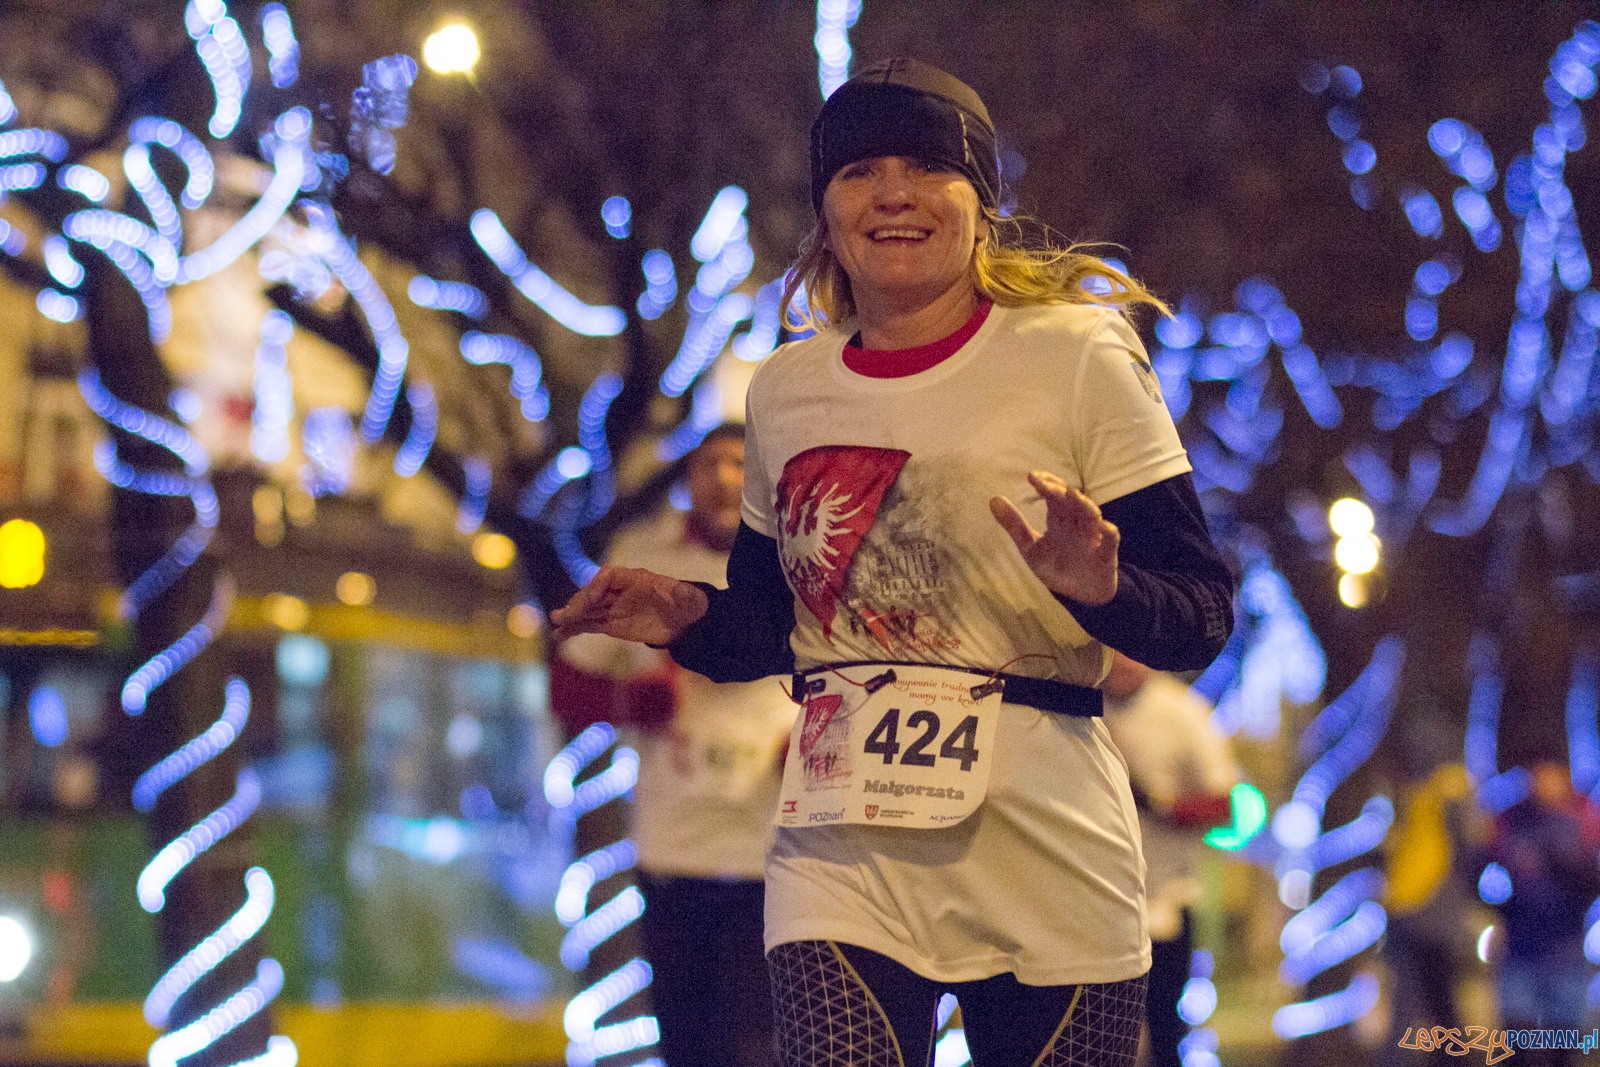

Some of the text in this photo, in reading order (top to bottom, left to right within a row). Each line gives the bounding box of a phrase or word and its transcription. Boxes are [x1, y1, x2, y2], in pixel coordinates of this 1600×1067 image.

[893, 679, 938, 692] onywanie
[909, 692, 937, 706] mamy
[940, 694, 954, 702] we
[863, 708, 979, 772] 424
[863, 779, 965, 800] Małgorzata
